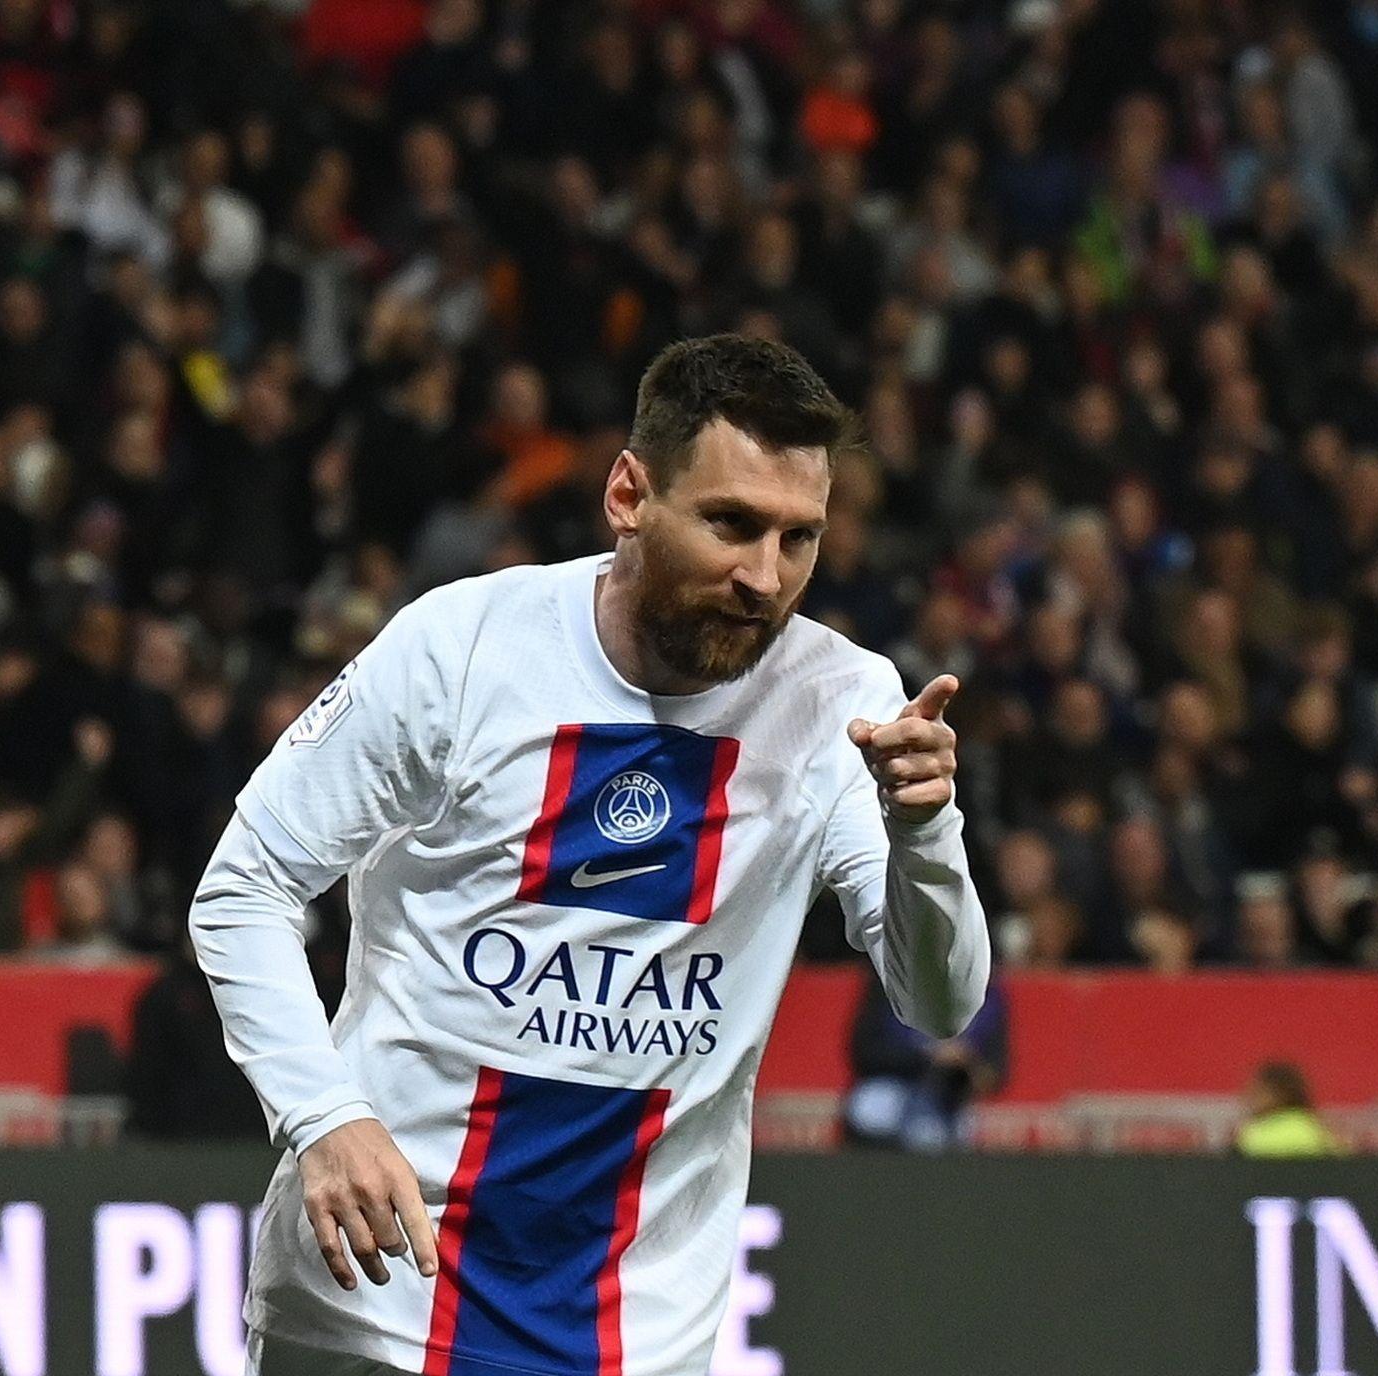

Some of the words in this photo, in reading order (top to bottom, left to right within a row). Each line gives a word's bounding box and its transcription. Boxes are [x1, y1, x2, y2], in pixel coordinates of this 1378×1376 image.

[611, 774, 659, 796] PARIS
[462, 927, 724, 1011] QATAR
[516, 1006, 719, 1057] AIRWAYS
